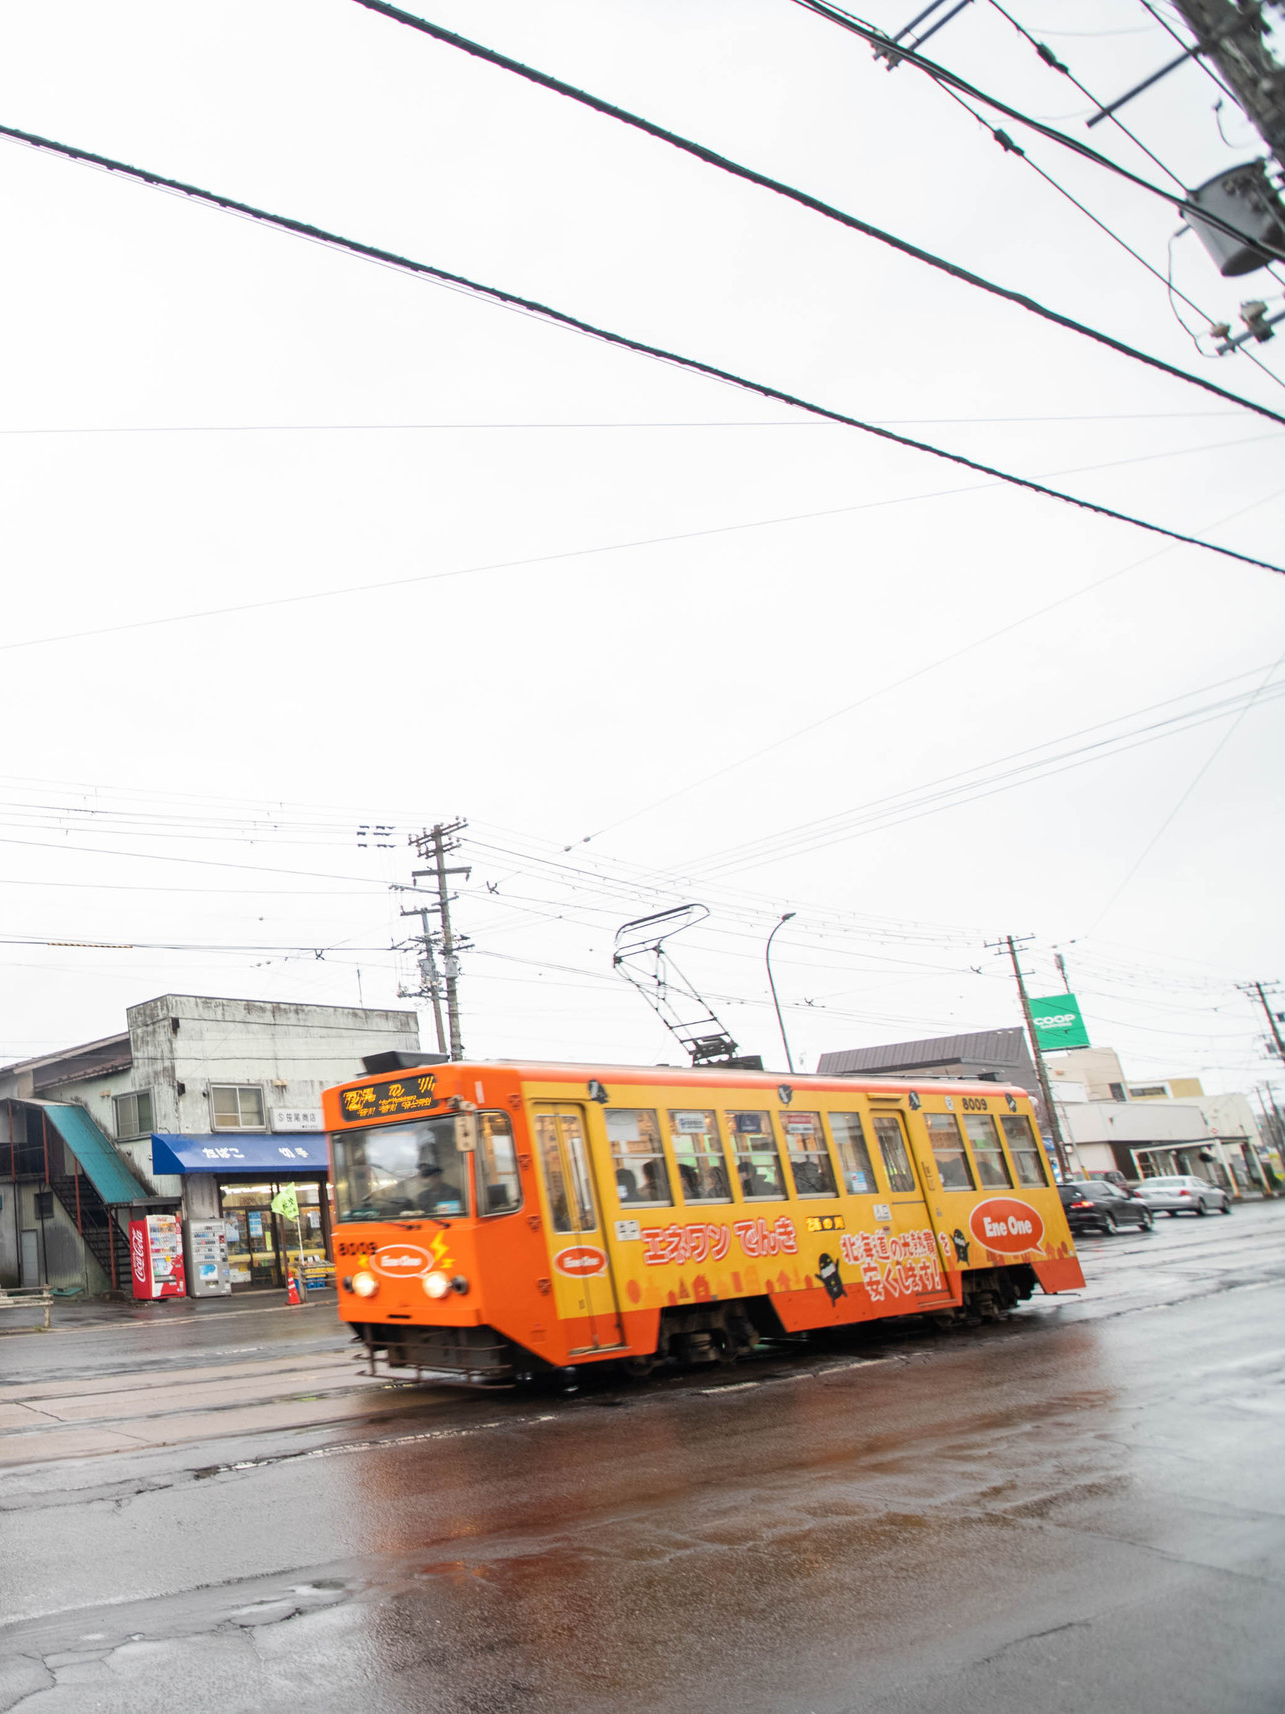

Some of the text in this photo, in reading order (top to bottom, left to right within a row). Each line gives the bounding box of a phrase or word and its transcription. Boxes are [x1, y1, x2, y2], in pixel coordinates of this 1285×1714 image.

[1033, 1014, 1076, 1026] COOP
[962, 1098, 988, 1111] 8009
[202, 1147, 245, 1159] たばこ
[983, 1216, 1033, 1237] Ene One
[642, 1216, 798, 1265] エネワン でんき
